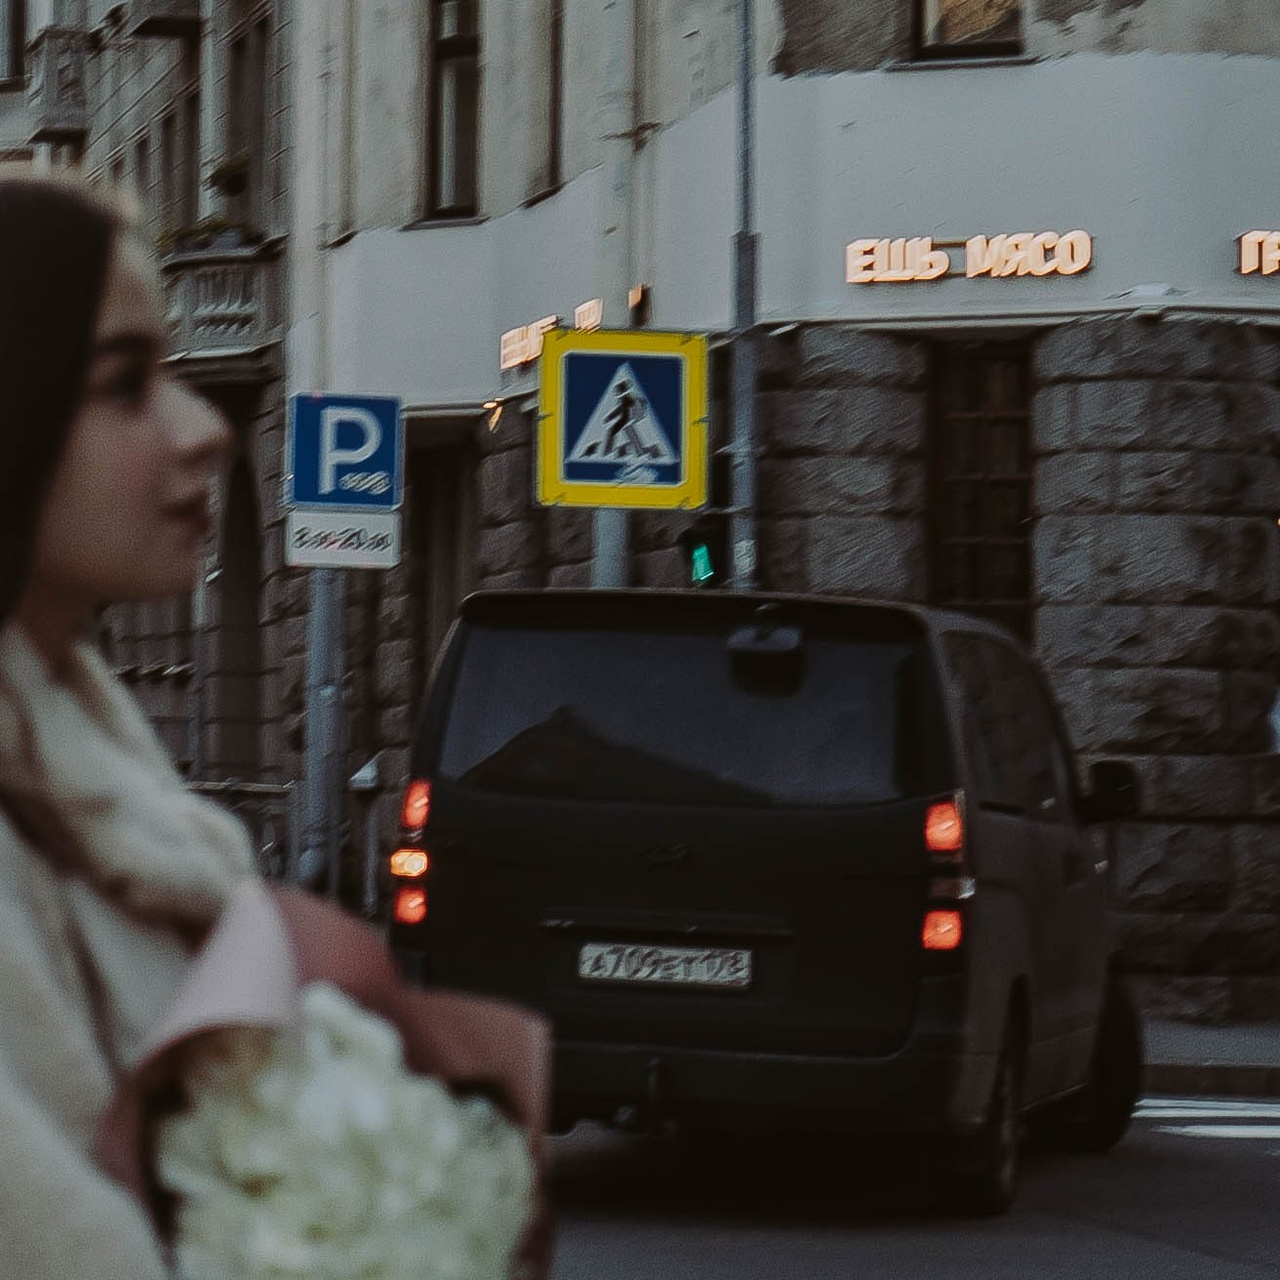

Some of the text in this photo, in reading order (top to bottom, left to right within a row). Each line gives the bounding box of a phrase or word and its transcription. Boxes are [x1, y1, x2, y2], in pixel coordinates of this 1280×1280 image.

[846, 229, 1092, 283] ЕШЬ МЯСО
[318, 405, 383, 496] P
